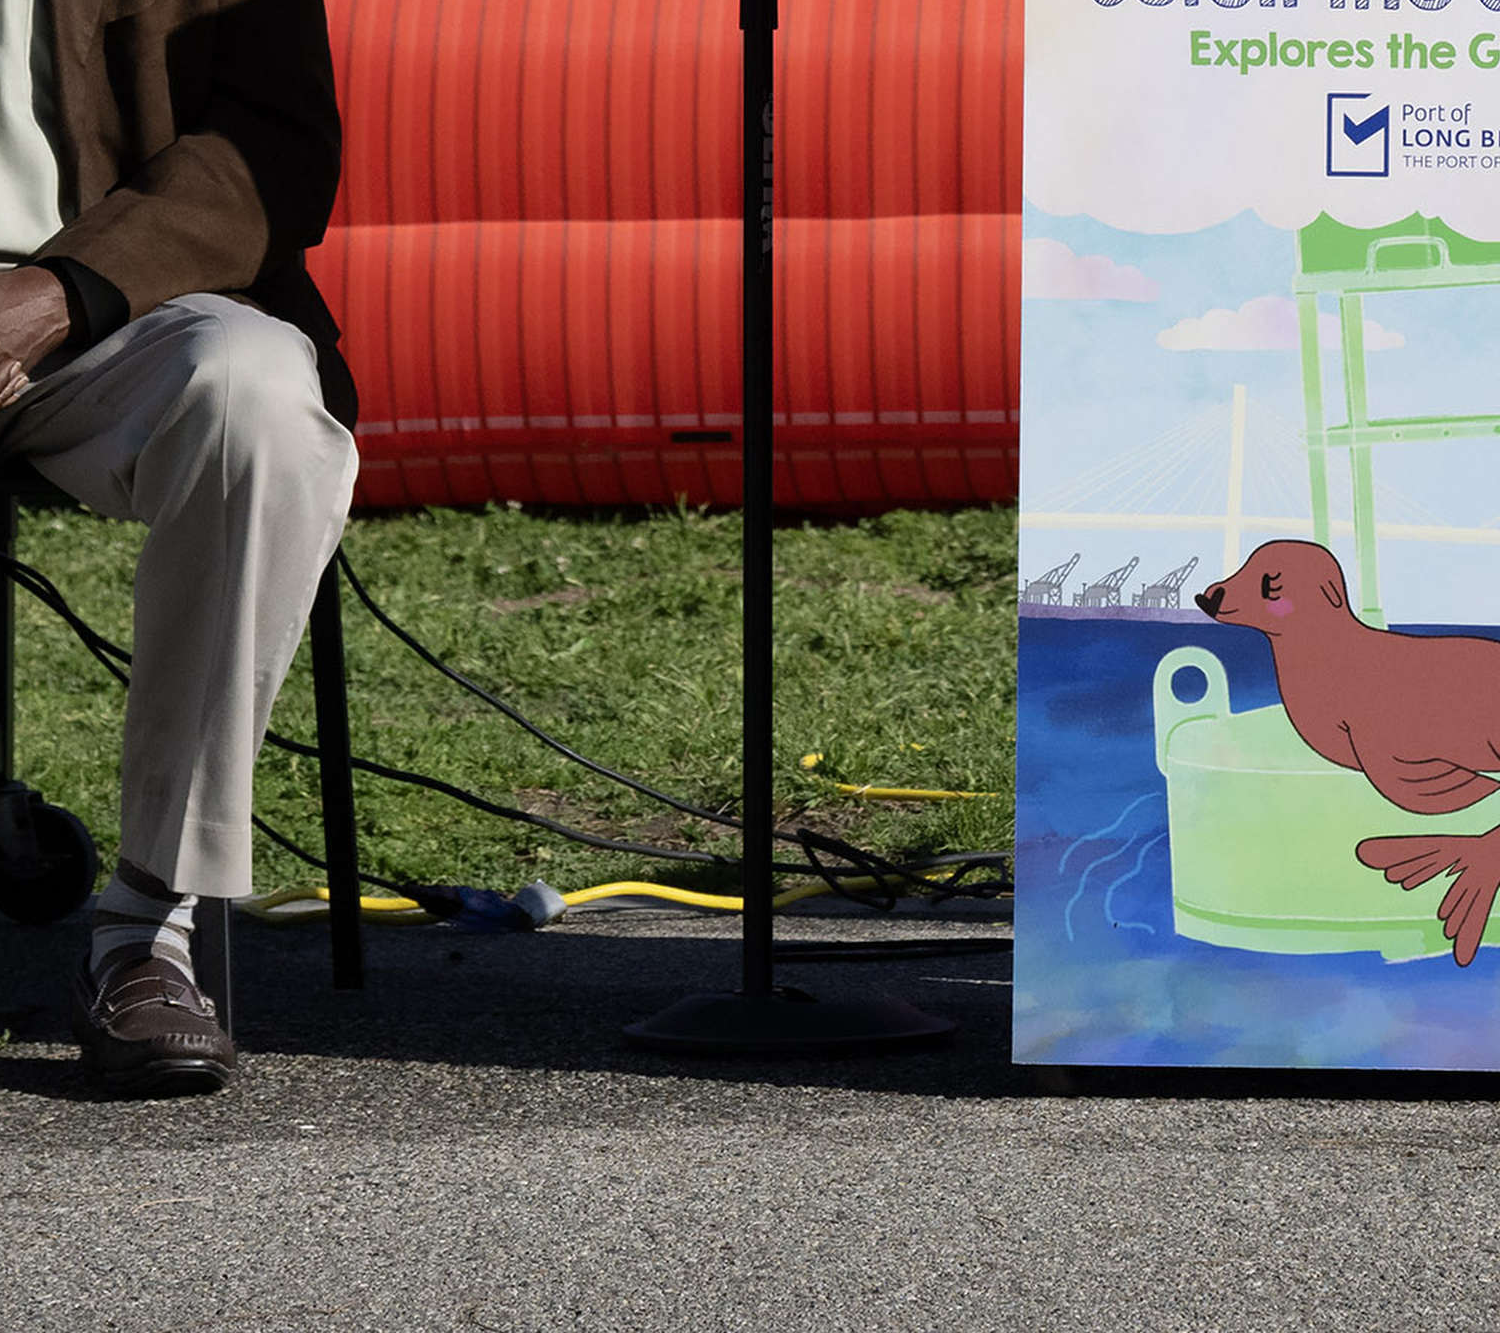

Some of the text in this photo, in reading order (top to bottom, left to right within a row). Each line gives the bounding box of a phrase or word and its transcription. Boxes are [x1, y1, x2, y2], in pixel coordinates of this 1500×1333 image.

[1190, 30, 1375, 75] Explores
[1386, 32, 1457, 70] the
[1402, 103, 1472, 126] Port of
[1402, 129, 1471, 148] LONG
[1403, 155, 1432, 169] THE
[1436, 155, 1477, 169] PORT
[1480, 156, 1500, 170] OF
